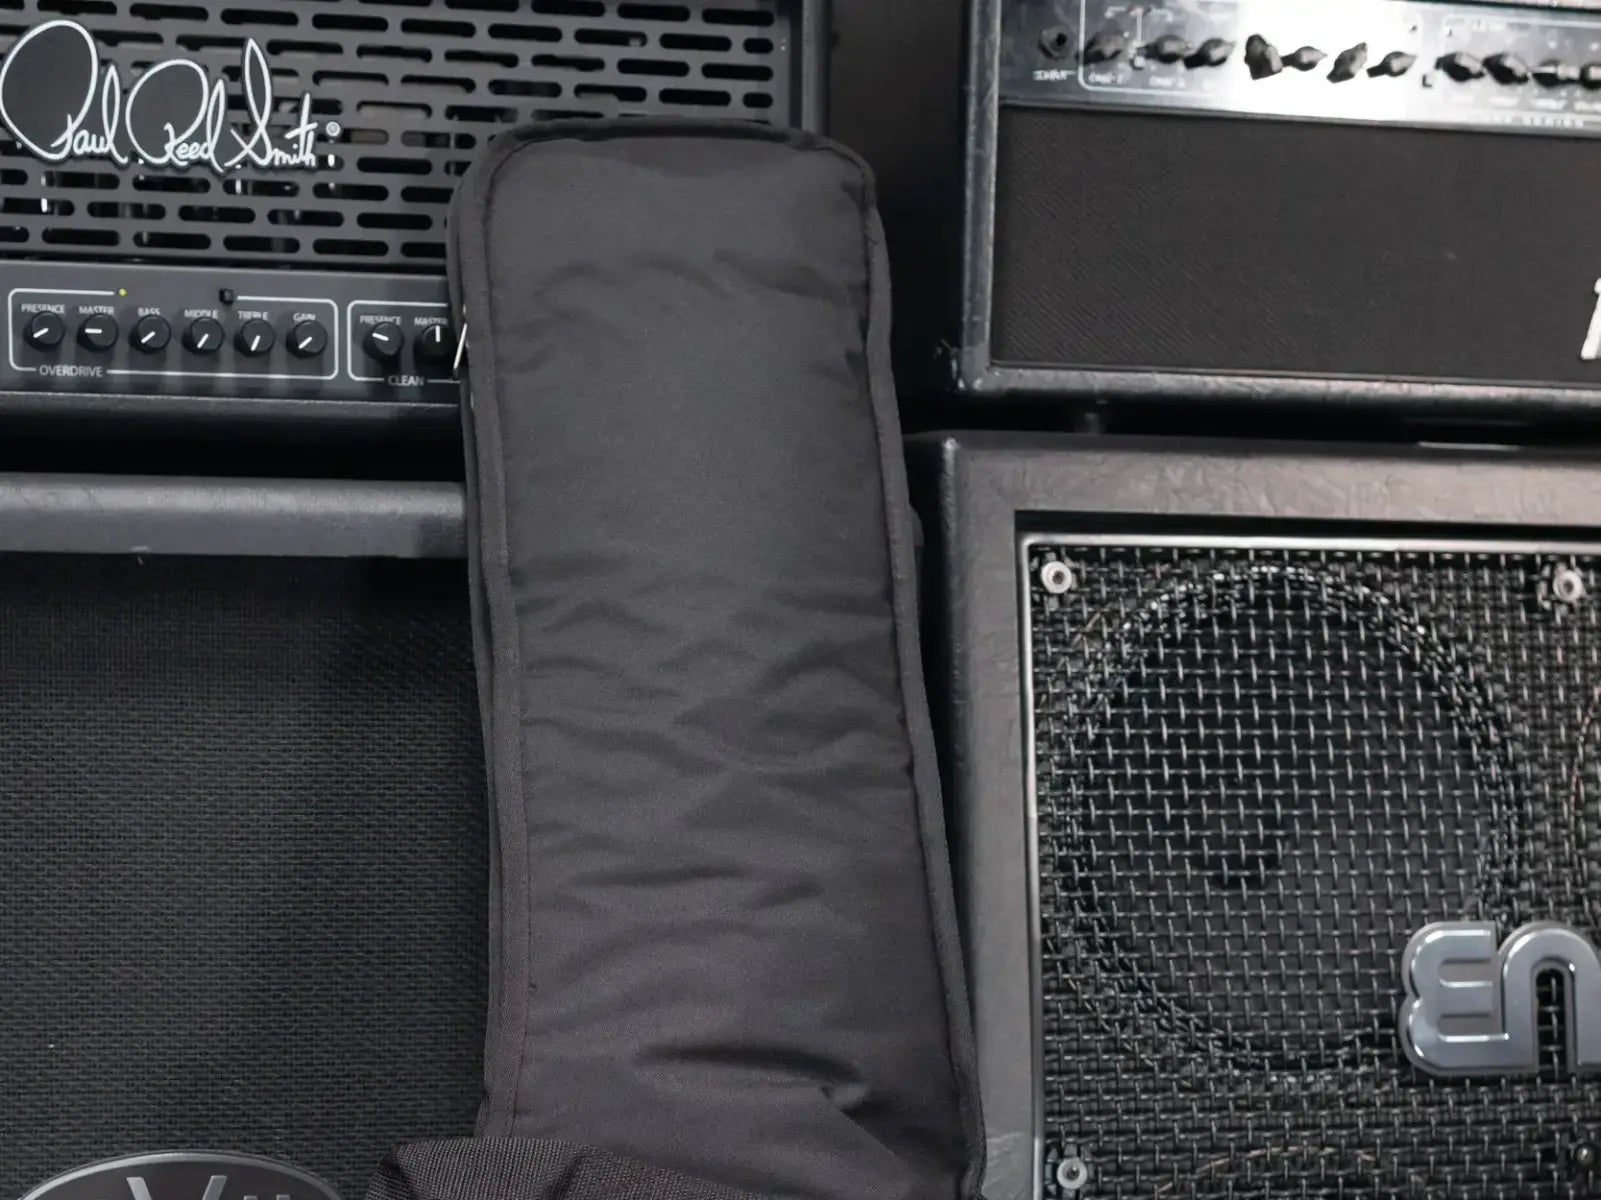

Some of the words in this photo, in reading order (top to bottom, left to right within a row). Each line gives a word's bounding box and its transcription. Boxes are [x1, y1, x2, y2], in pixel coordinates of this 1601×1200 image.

[0, 20, 128, 165] Paul
[125, 58, 225, 174] Reed
[223, 38, 318, 168] Smith
[39, 364, 103, 378] OVERDRIVE
[388, 374, 425, 387] CLEAN
